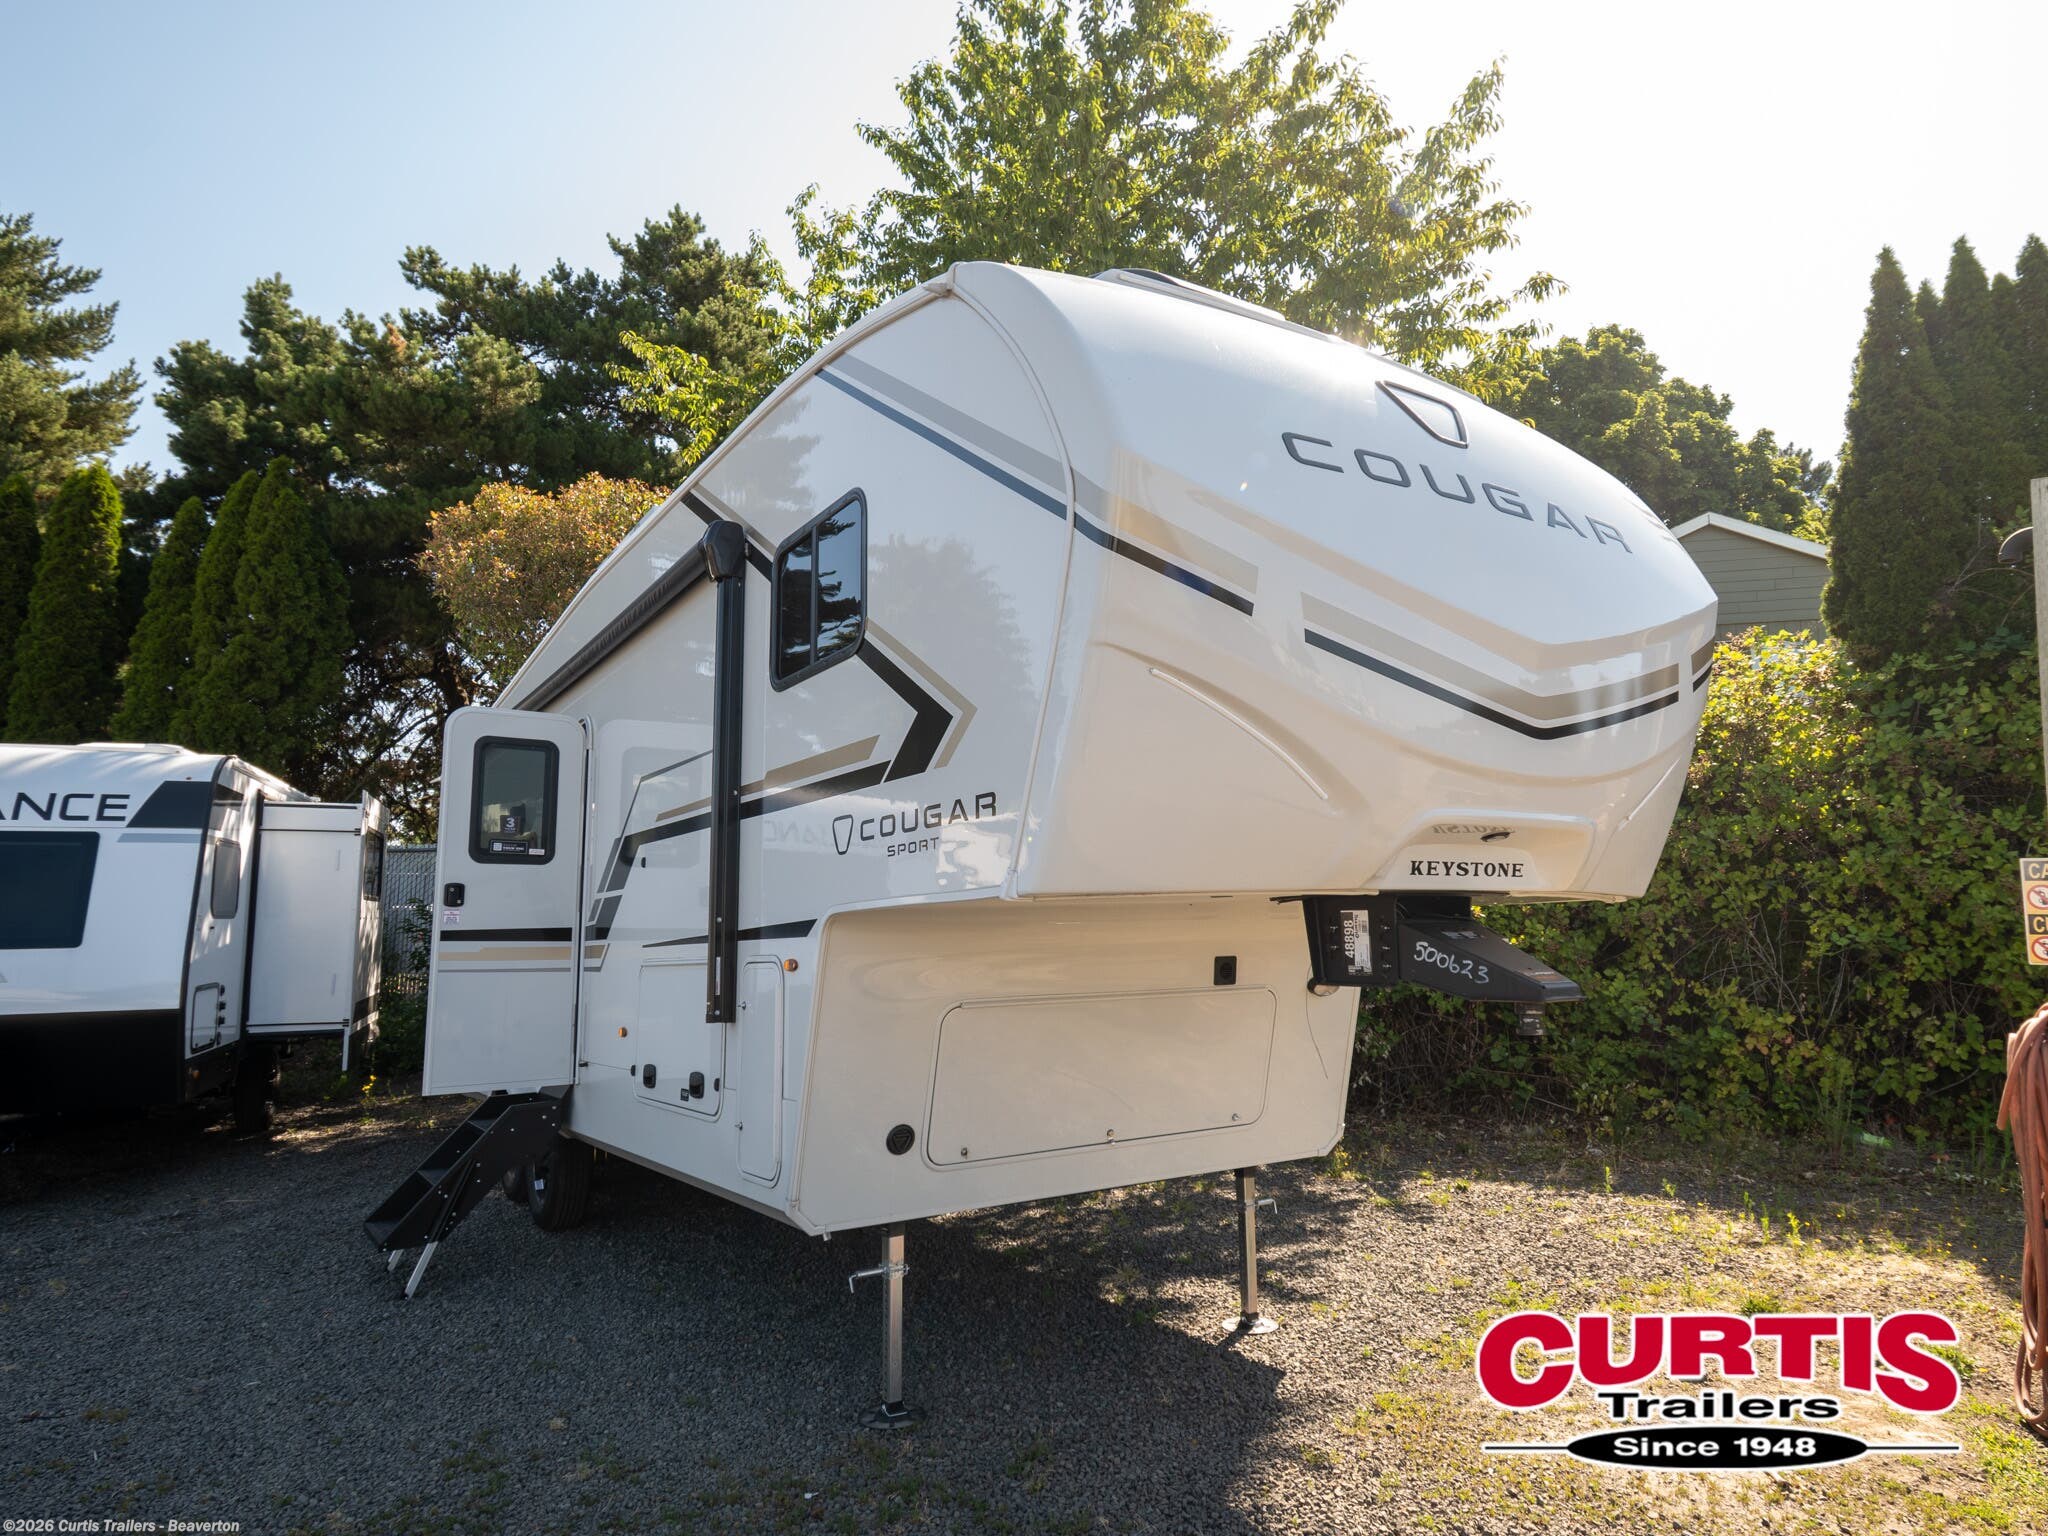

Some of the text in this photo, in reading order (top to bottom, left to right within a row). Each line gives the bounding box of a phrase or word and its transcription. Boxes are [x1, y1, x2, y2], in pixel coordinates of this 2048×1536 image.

[1281, 431, 1633, 554] COUGAR
[0, 792, 131, 822] NCE
[859, 791, 998, 842] COUGAR
[887, 836, 940, 857] SPORT
[1409, 860, 1525, 878] KEYSTONE
[1344, 919, 1355, 959] 48898
[1413, 941, 1489, 984] 500623
